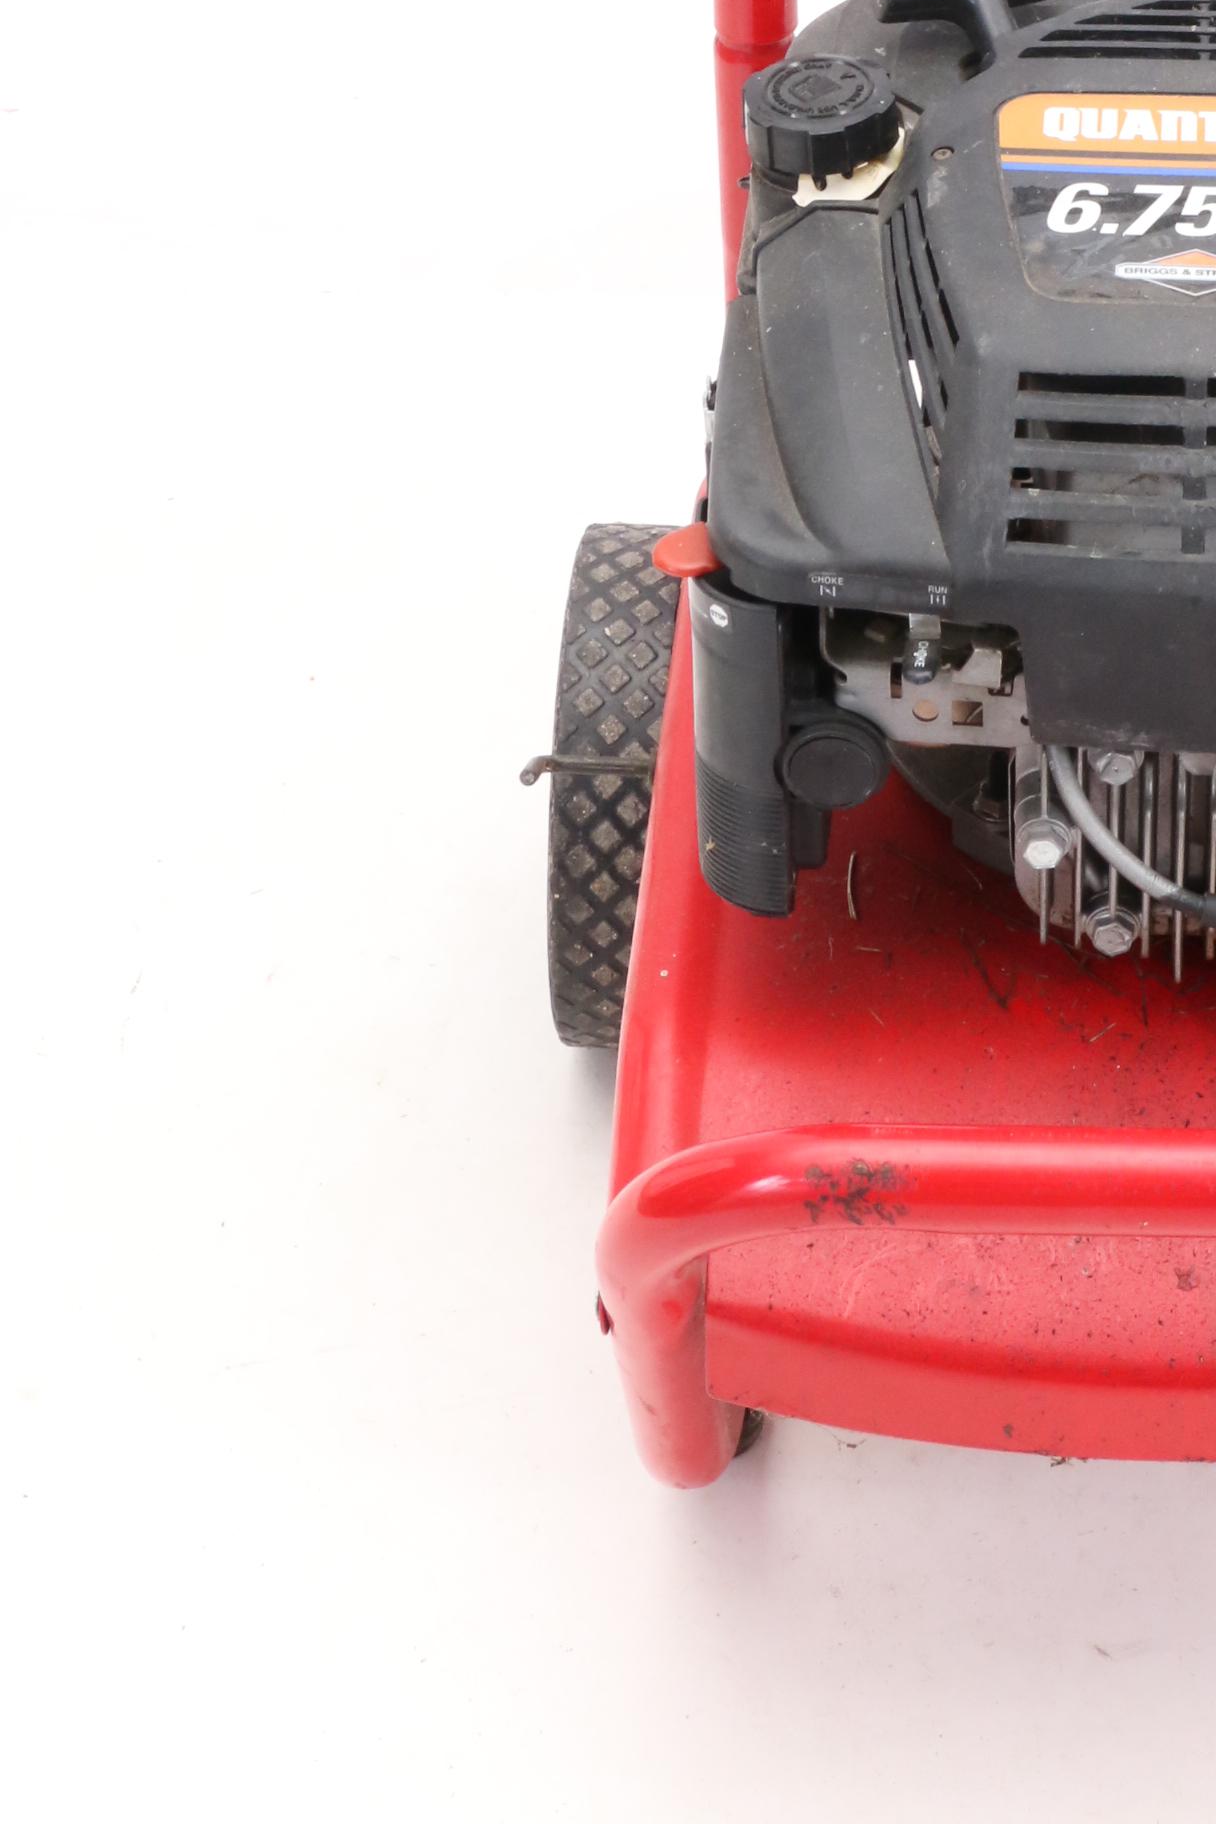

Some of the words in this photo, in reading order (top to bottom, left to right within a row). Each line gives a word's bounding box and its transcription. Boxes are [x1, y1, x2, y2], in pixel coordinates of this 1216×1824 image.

[1123, 267, 1179, 278] BRIGGS
[1182, 268, 1192, 278] &
[811, 575, 845, 586] CHOKE
[927, 584, 948, 595] RUN
